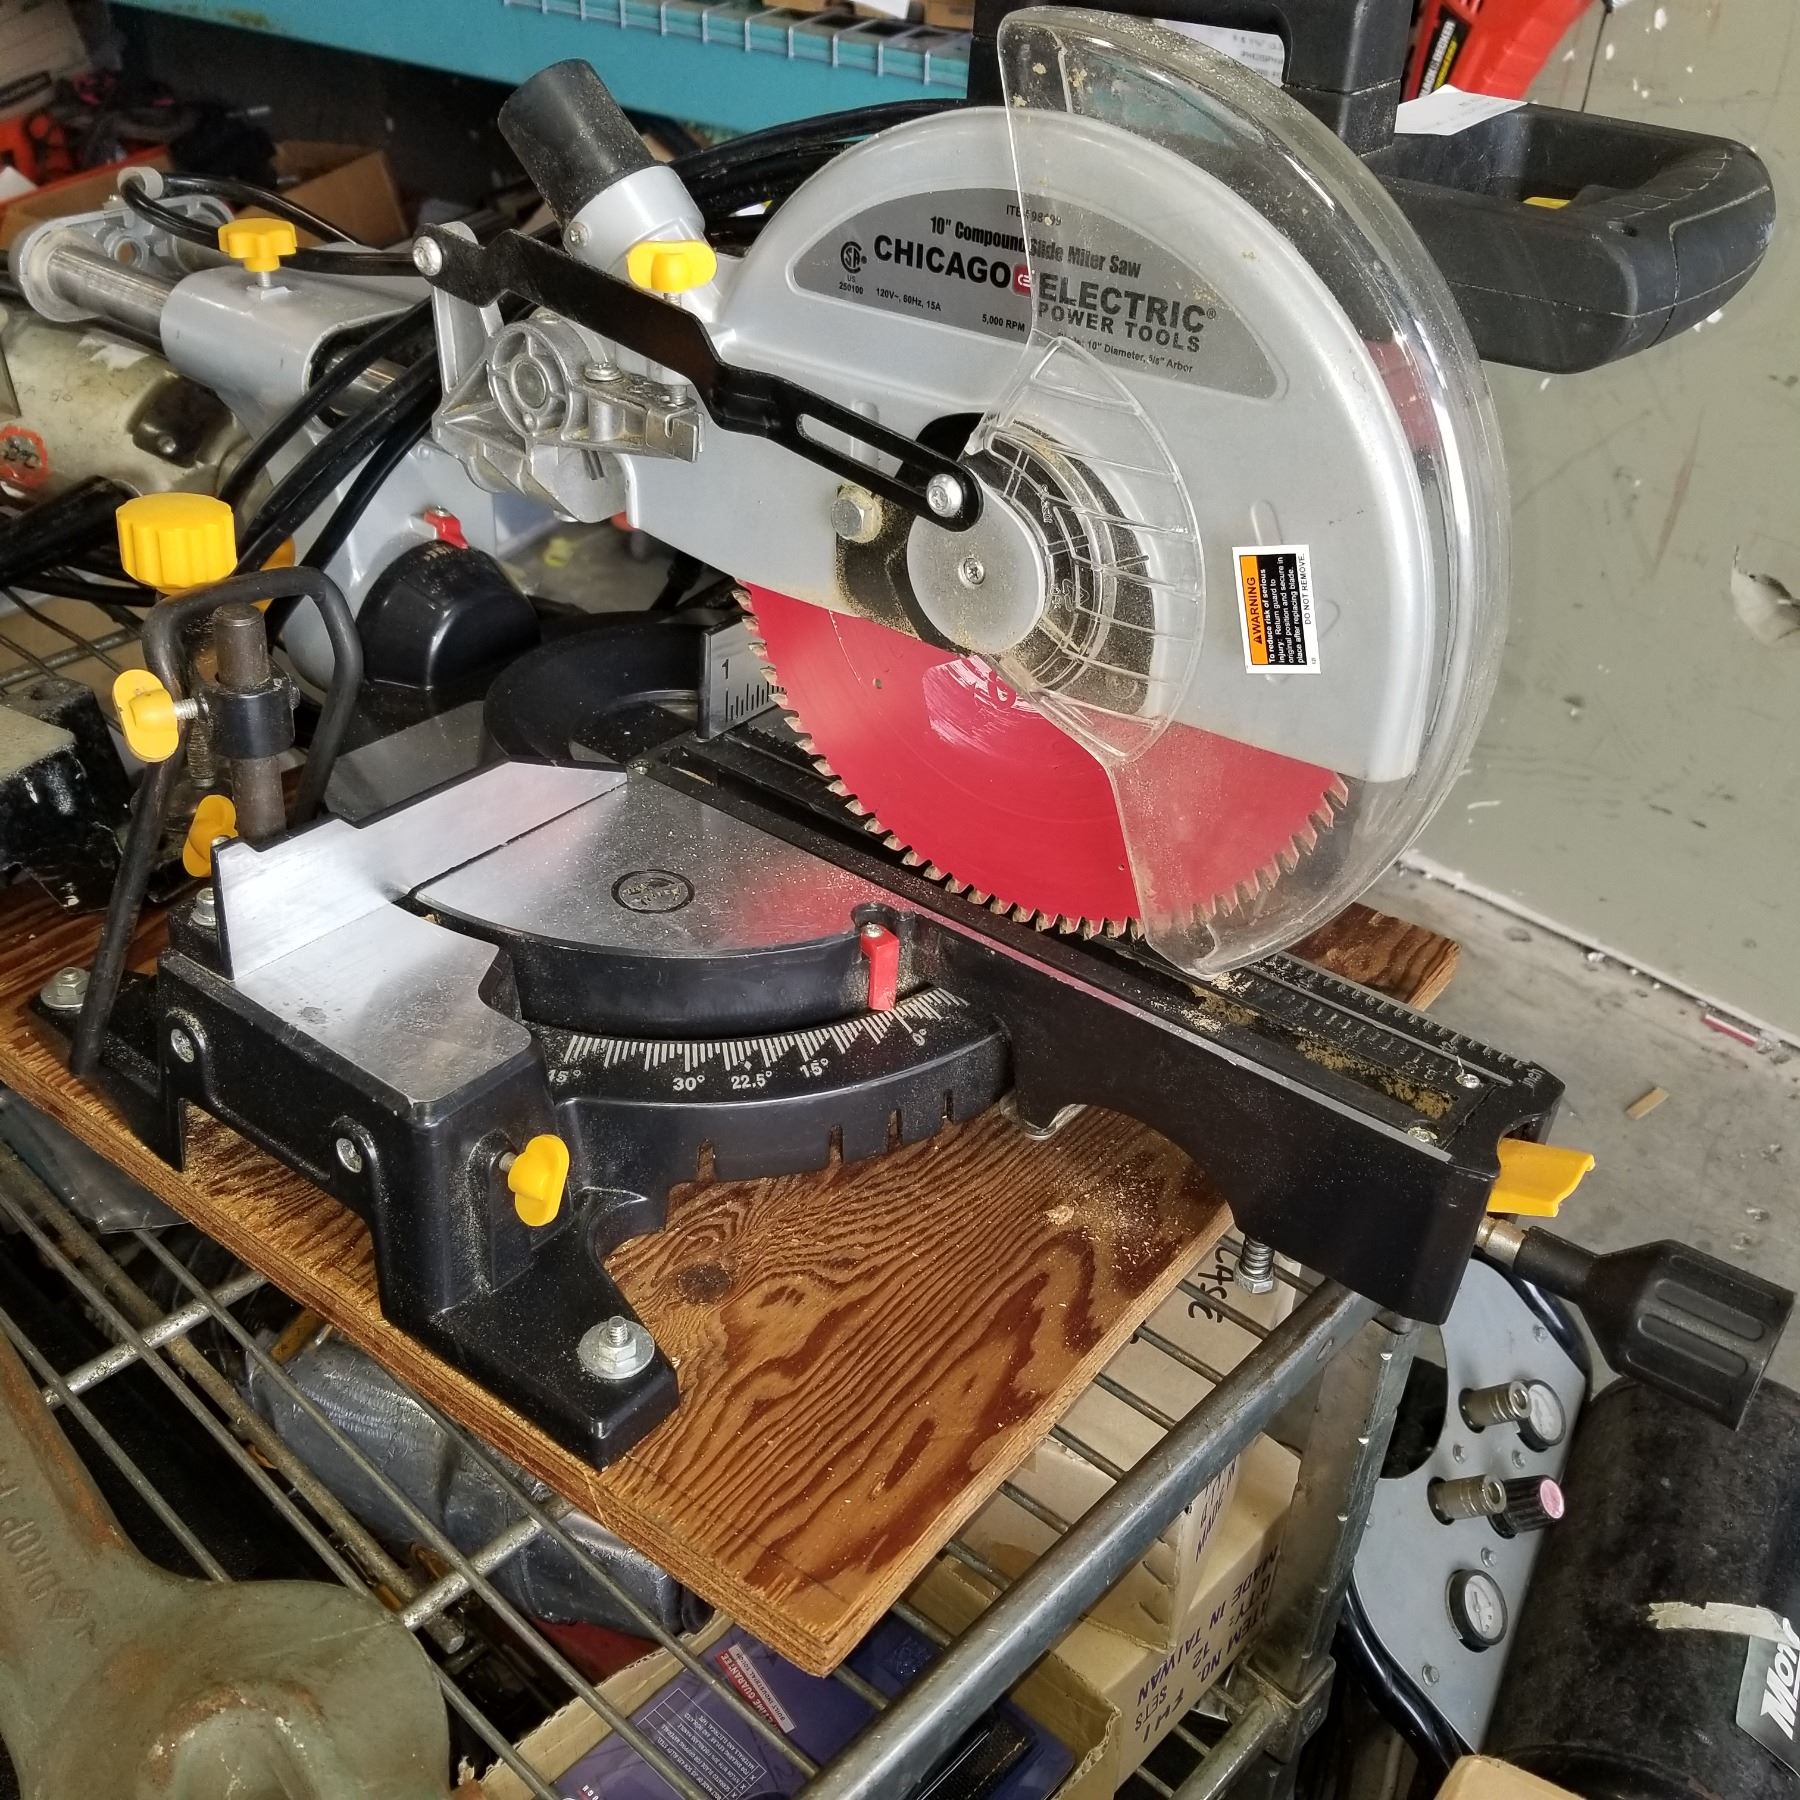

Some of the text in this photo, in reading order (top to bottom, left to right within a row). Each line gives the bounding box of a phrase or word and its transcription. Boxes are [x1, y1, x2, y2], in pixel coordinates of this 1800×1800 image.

[874, 234, 1011, 289] CHICAGO
[930, 216, 951, 235] 10"
[955, 221, 1026, 253] Compound
[1068, 245, 1106, 271] Miter
[1109, 255, 1142, 279] Saw
[839, 281, 864, 295] 250100
[903, 294, 924, 309] 60Hz,
[927, 301, 941, 312] 15A
[982, 314, 1025, 332] 5,000 RPM
[1038, 302, 1200, 353] POWER TOOLS
[1104, 345, 1146, 363] Diameter,
[1167, 359, 1193, 374] Arbor
[1270, 579, 1276, 587] to
[1298, 553, 1312, 625] DO NOT REMOVE.
[1246, 577, 1261, 636] WARNING
[1270, 588, 1279, 609] guard
[1276, 557, 1295, 663] original position and secure in
[1260, 569, 1276, 663] To reduce risk of serious
[1274, 610, 1282, 635] Return
[1288, 567, 1305, 663] place after replacing blade.
[721, 659, 729, 680] 1
[672, 1074, 705, 1092] 30°
[731, 1071, 772, 1089] 22.5°
[800, 1058, 829, 1078] 15°
[1137, 1545, 1278, 1705] MADE IN TAIWAN
[1227, 1601, 1266, 1660] ITEM
[1192, 1641, 1211, 1670] 12
[1197, 1653, 1221, 1683] NO.
[719, 1652, 756, 1699] GUARANTEE
[1135, 1685, 1167, 1731] SETS
